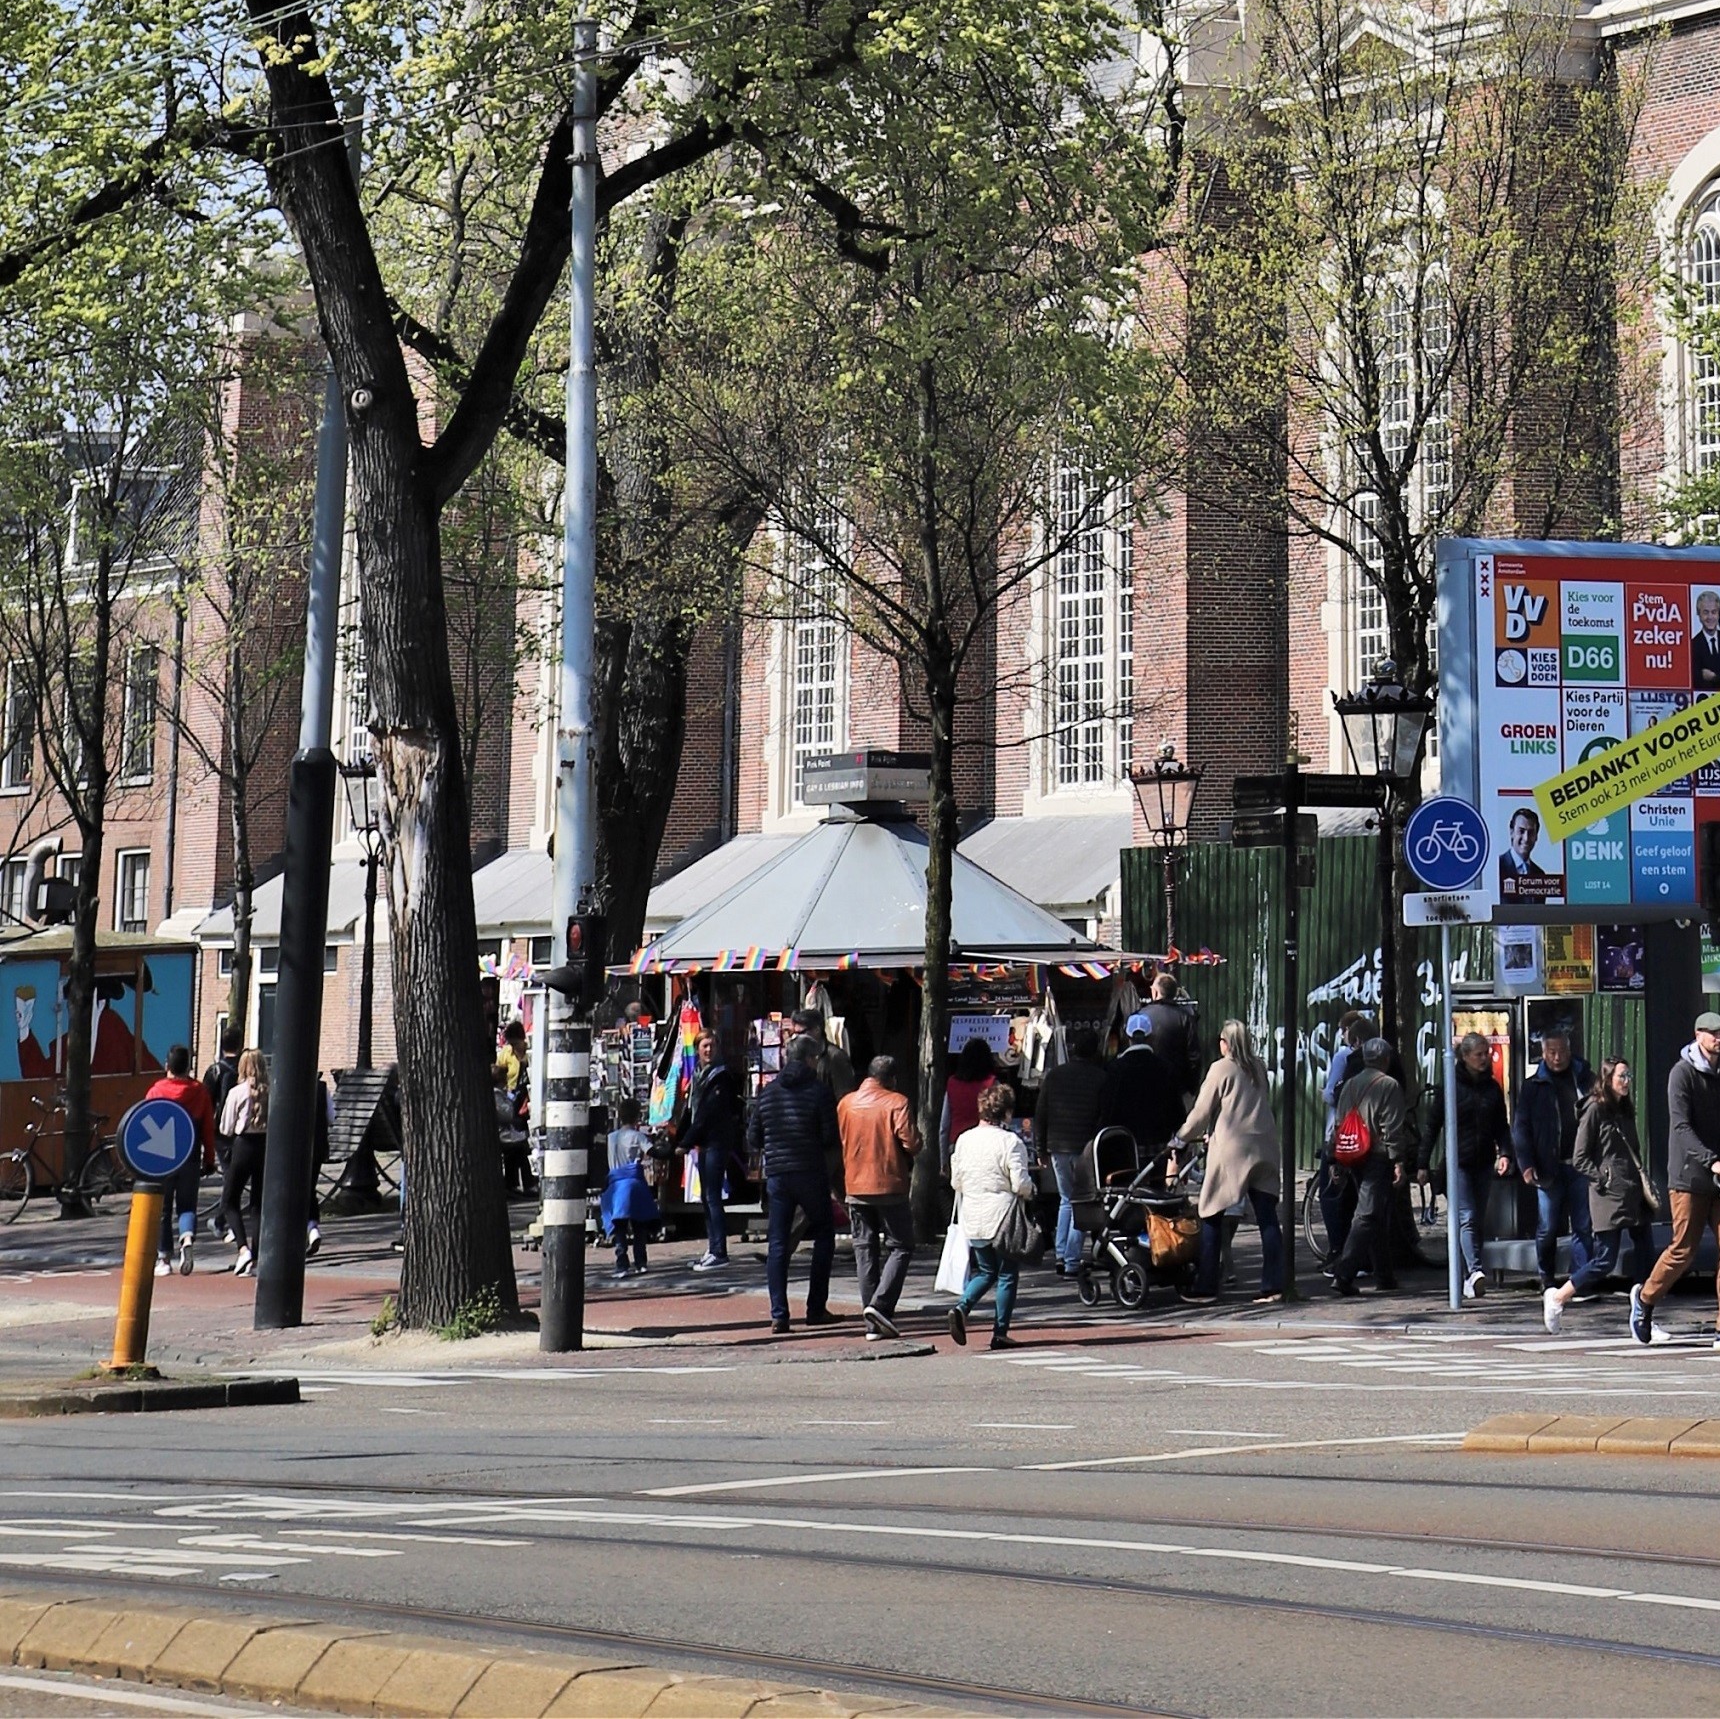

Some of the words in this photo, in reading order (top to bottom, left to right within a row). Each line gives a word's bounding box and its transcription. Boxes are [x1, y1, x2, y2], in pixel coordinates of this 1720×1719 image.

[1568, 591, 1589, 603] Kies
[1590, 594, 1615, 603] voor
[1638, 592, 1665, 604] Stem
[1568, 603, 1580, 614] de
[1633, 602, 1683, 623] PvdA
[1568, 616, 1615, 628] toekomst
[1634, 625, 1684, 645] zeker
[1531, 652, 1558, 663] KIES
[1568, 646, 1614, 669] D66
[1646, 650, 1673, 669] nu!
[1531, 663, 1558, 672] VOOR
[1531, 672, 1558, 682] DOEN
[1566, 691, 1591, 704] Kies
[1593, 691, 1624, 706] Partij
[1640, 692, 1674, 703] LIJST
[1566, 707, 1593, 718] voor
[1595, 706, 1610, 718] de
[1501, 724, 1557, 739] GROEN
[1566, 719, 1605, 732] Dieren
[1510, 740, 1557, 755] LINKS
[1549, 747, 1640, 808] BEDANKT
[1644, 716, 1704, 757] VOOR
[1558, 806, 1589, 825] Stem
[1590, 788, 1613, 809] ook
[1614, 781, 1628, 798] 23
[1629, 768, 1652, 789] mei
[1652, 757, 1678, 777] voor
[1678, 743, 1699, 762] het
[1638, 803, 1686, 815] Christen
[1649, 815, 1675, 827] Unie
[1571, 840, 1624, 861] DENK
[1635, 845, 1659, 857] Geef
[1660, 845, 1692, 859] geloof
[1641, 865, 1660, 876] een
[1662, 865, 1686, 875] stem
[1518, 877, 1542, 886] Forum
[1544, 878, 1560, 886] voor
[1518, 886, 1562, 896] Democratie
[1423, 894, 1470, 903] snorfietsen
